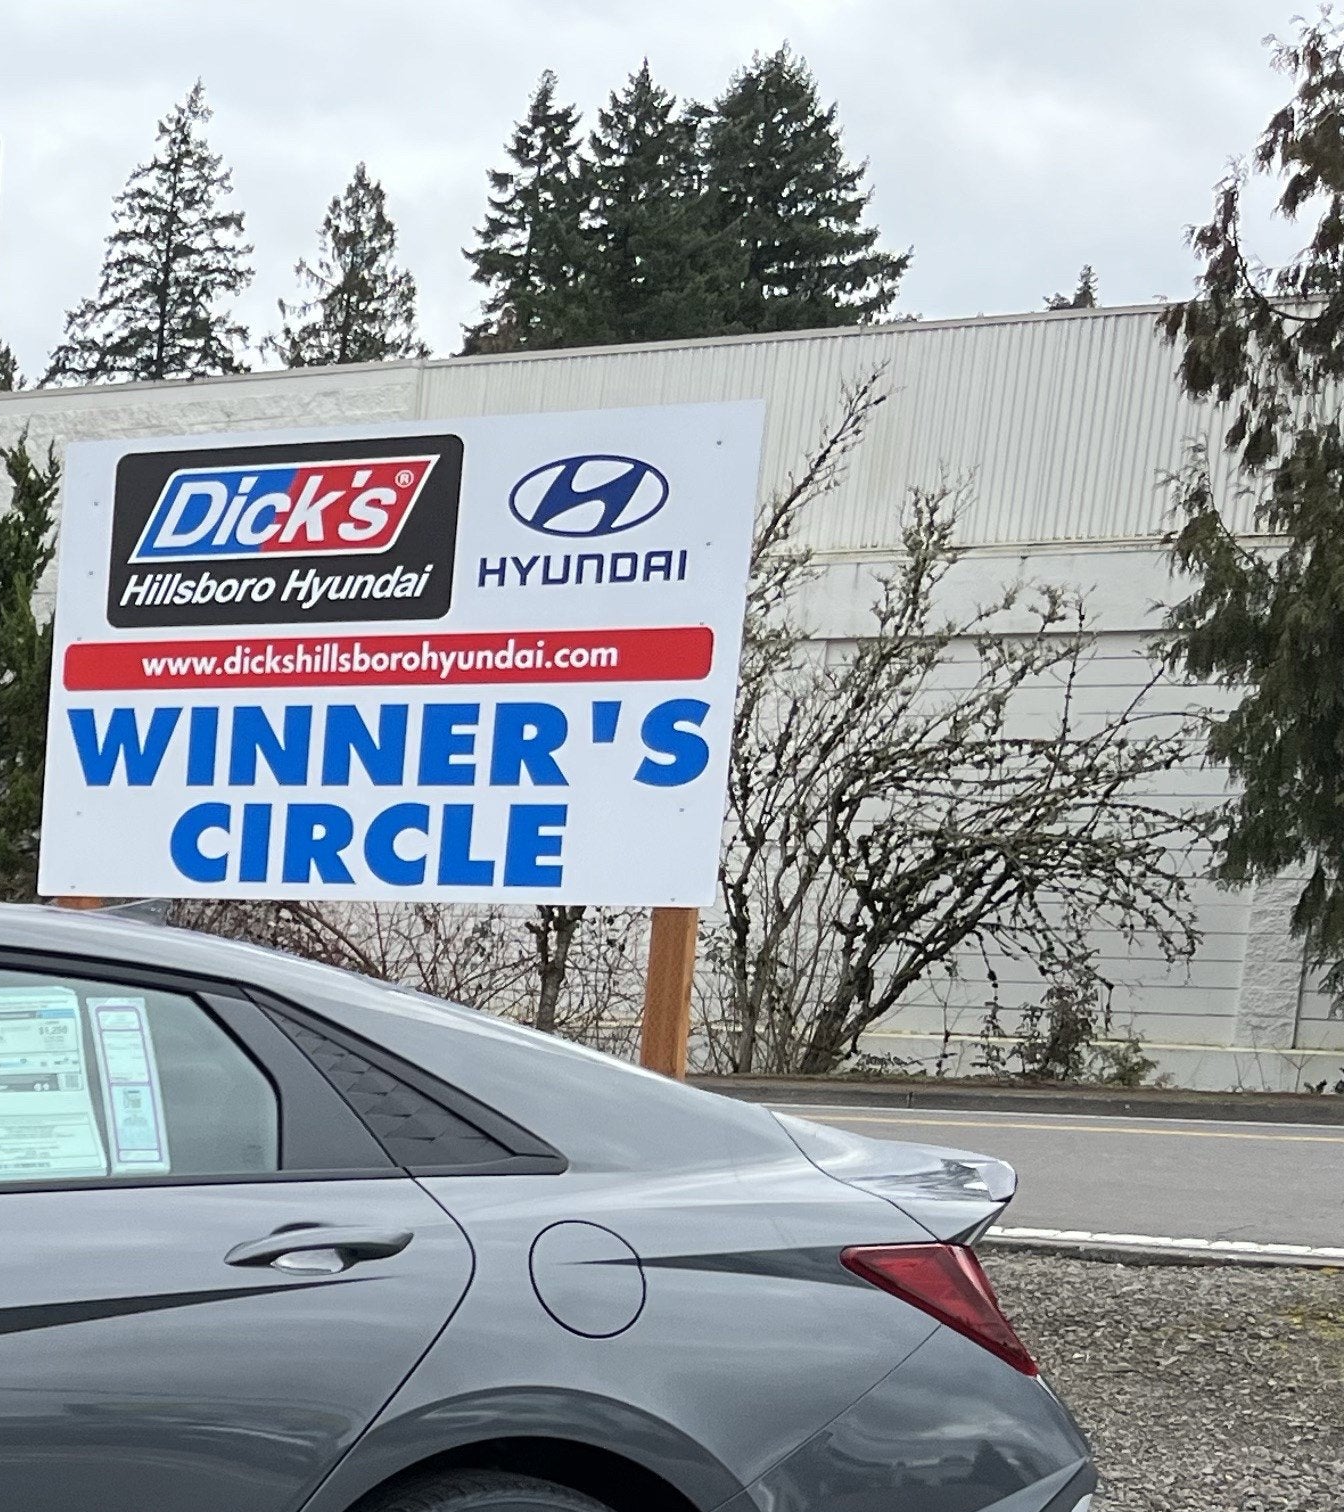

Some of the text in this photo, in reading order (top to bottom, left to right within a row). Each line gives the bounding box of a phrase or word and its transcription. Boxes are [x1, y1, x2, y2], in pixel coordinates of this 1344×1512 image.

[153, 470, 397, 548] Dick's
[120, 564, 434, 609] Hillsboro Hyundai
[478, 550, 687, 587] HYUNDAI
[141, 638, 619, 680] www.dickshillsborohyundai.com
[68, 699, 712, 787] WINNER'S
[170, 802, 569, 888] CIRCLE
